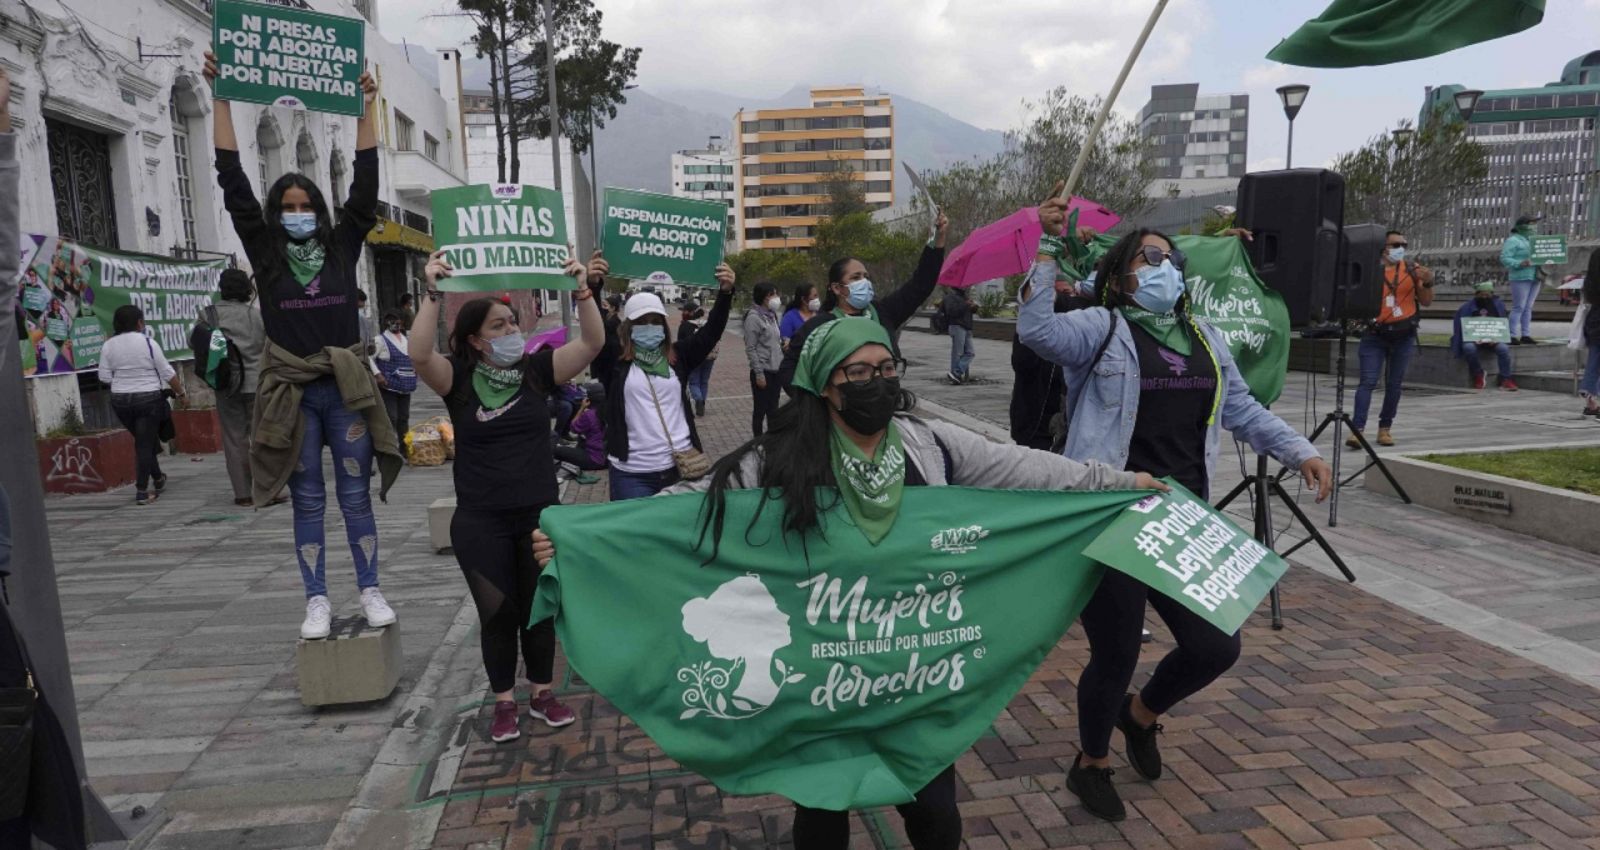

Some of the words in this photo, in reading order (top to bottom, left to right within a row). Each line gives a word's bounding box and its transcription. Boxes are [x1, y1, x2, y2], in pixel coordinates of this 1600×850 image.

[219, 28, 261, 50] POR
[267, 36, 357, 64] ABORTAR
[241, 14, 262, 32] NI
[267, 18, 336, 44] PRESAS
[220, 63, 262, 85] POR
[268, 70, 356, 97] INTENTAR
[234, 48, 254, 66] NI
[259, 52, 343, 79] MUERTAS
[455, 200, 555, 238] NIÑAS
[608, 205, 722, 232] DESPENALIZACIÓN
[619, 222, 644, 239] DEL
[648, 227, 709, 246] ABORTO
[446, 247, 480, 270] NO
[485, 246, 567, 269] MADRES
[631, 241, 695, 261] AHORA!!
[129, 292, 162, 321] DEL
[1186, 275, 1262, 319] Mujeres
[1133, 499, 1210, 559] #PorUna
[1181, 539, 1269, 612] Reparadora
[796, 572, 965, 641] Mujeres
[811, 637, 892, 659] RESISTIENDO
[896, 636, 919, 651] POR
[922, 625, 982, 648] NUESTROS
[810, 652, 967, 712] derechos
